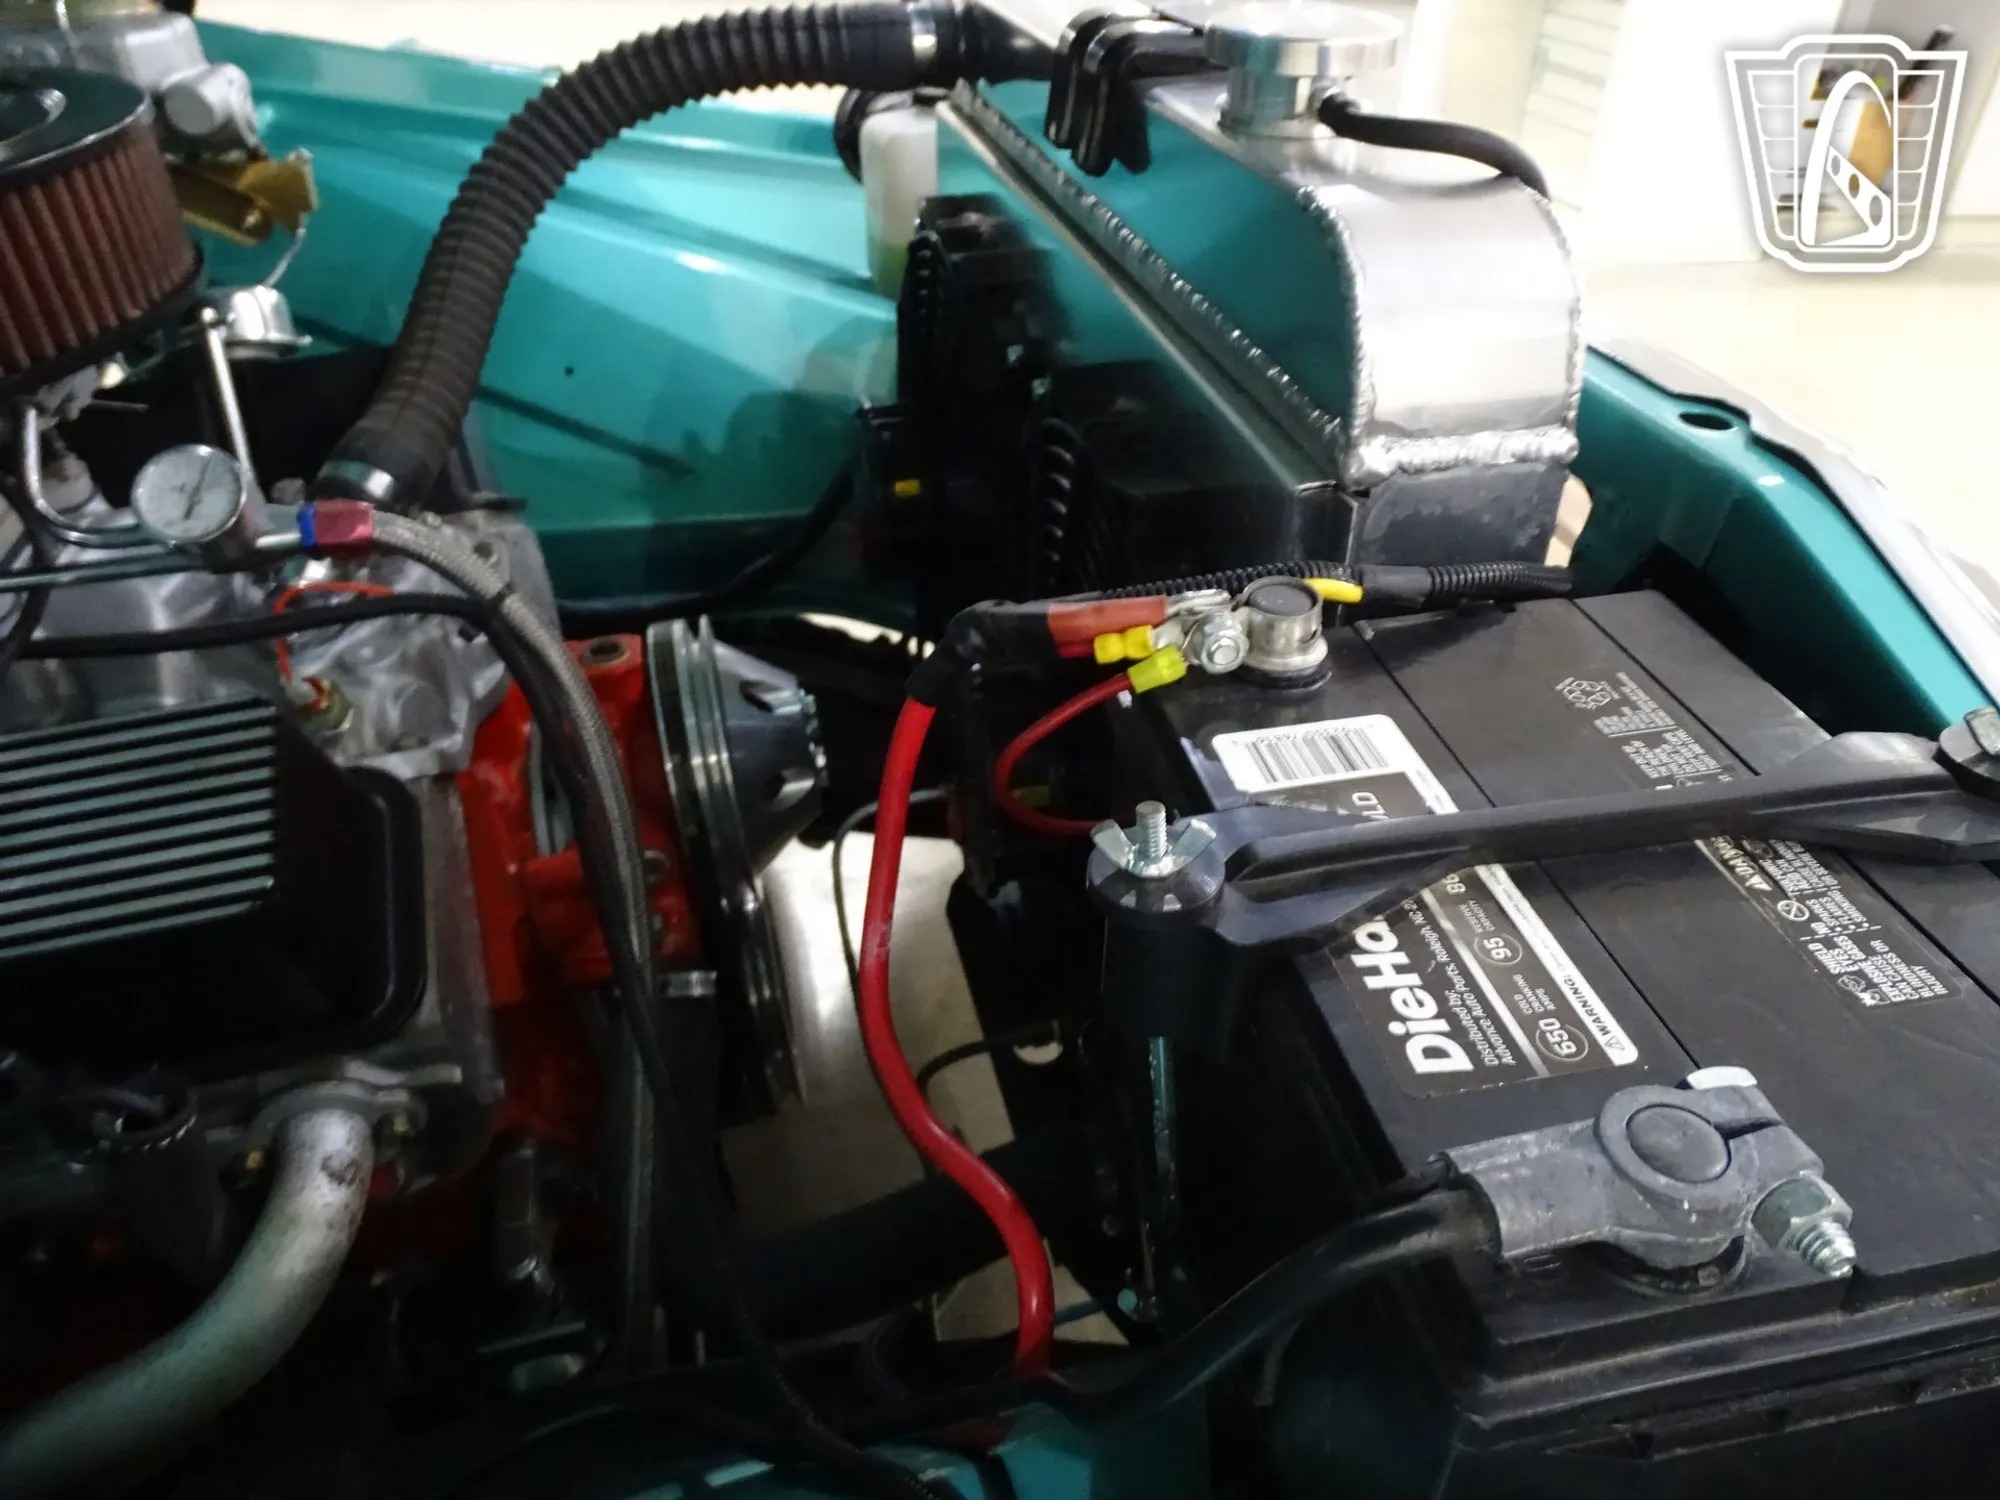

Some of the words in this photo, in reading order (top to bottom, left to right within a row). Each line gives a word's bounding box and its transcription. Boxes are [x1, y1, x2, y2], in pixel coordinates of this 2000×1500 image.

[1352, 792, 1389, 819] LD
[1711, 835, 1755, 877] DANGE
[1459, 904, 1484, 933] RESERVE
[1469, 900, 1495, 931] CAPACITY
[1806, 899, 1840, 926] SPARKS
[1819, 897, 1853, 924] FLAMES
[1828, 890, 1866, 922] SMOKING
[1811, 922, 1831, 934] NO
[1483, 937, 1512, 959] 95
[1808, 943, 1845, 974] SHIELD
[1829, 948, 1860, 971] EYES
[1833, 936, 1866, 960] GASES
[1870, 940, 1889, 952] OR
[1857, 960, 1906, 1001] EXPLOSIVE
[1869, 955, 1902, 981] CAUSE
[1883, 952, 1934, 997] BLINDNESS
[1910, 966, 1948, 994] INJURY
[1352, 916, 1473, 1073] DieHa
[1445, 990, 1462, 1005] by:
[1513, 974, 1544, 1012] CRANKING
[1514, 994, 1533, 1014] COLD
[1535, 988, 1556, 1010] AMPS
[1895, 982, 1920, 999] CAN
[1463, 993, 1486, 1016] Auto
[1564, 978, 1611, 1035] WARNING:
[1452, 1007, 1499, 1066] Distributed
[1479, 1019, 1516, 1064] Advance
[1538, 1018, 1577, 1055] 650
